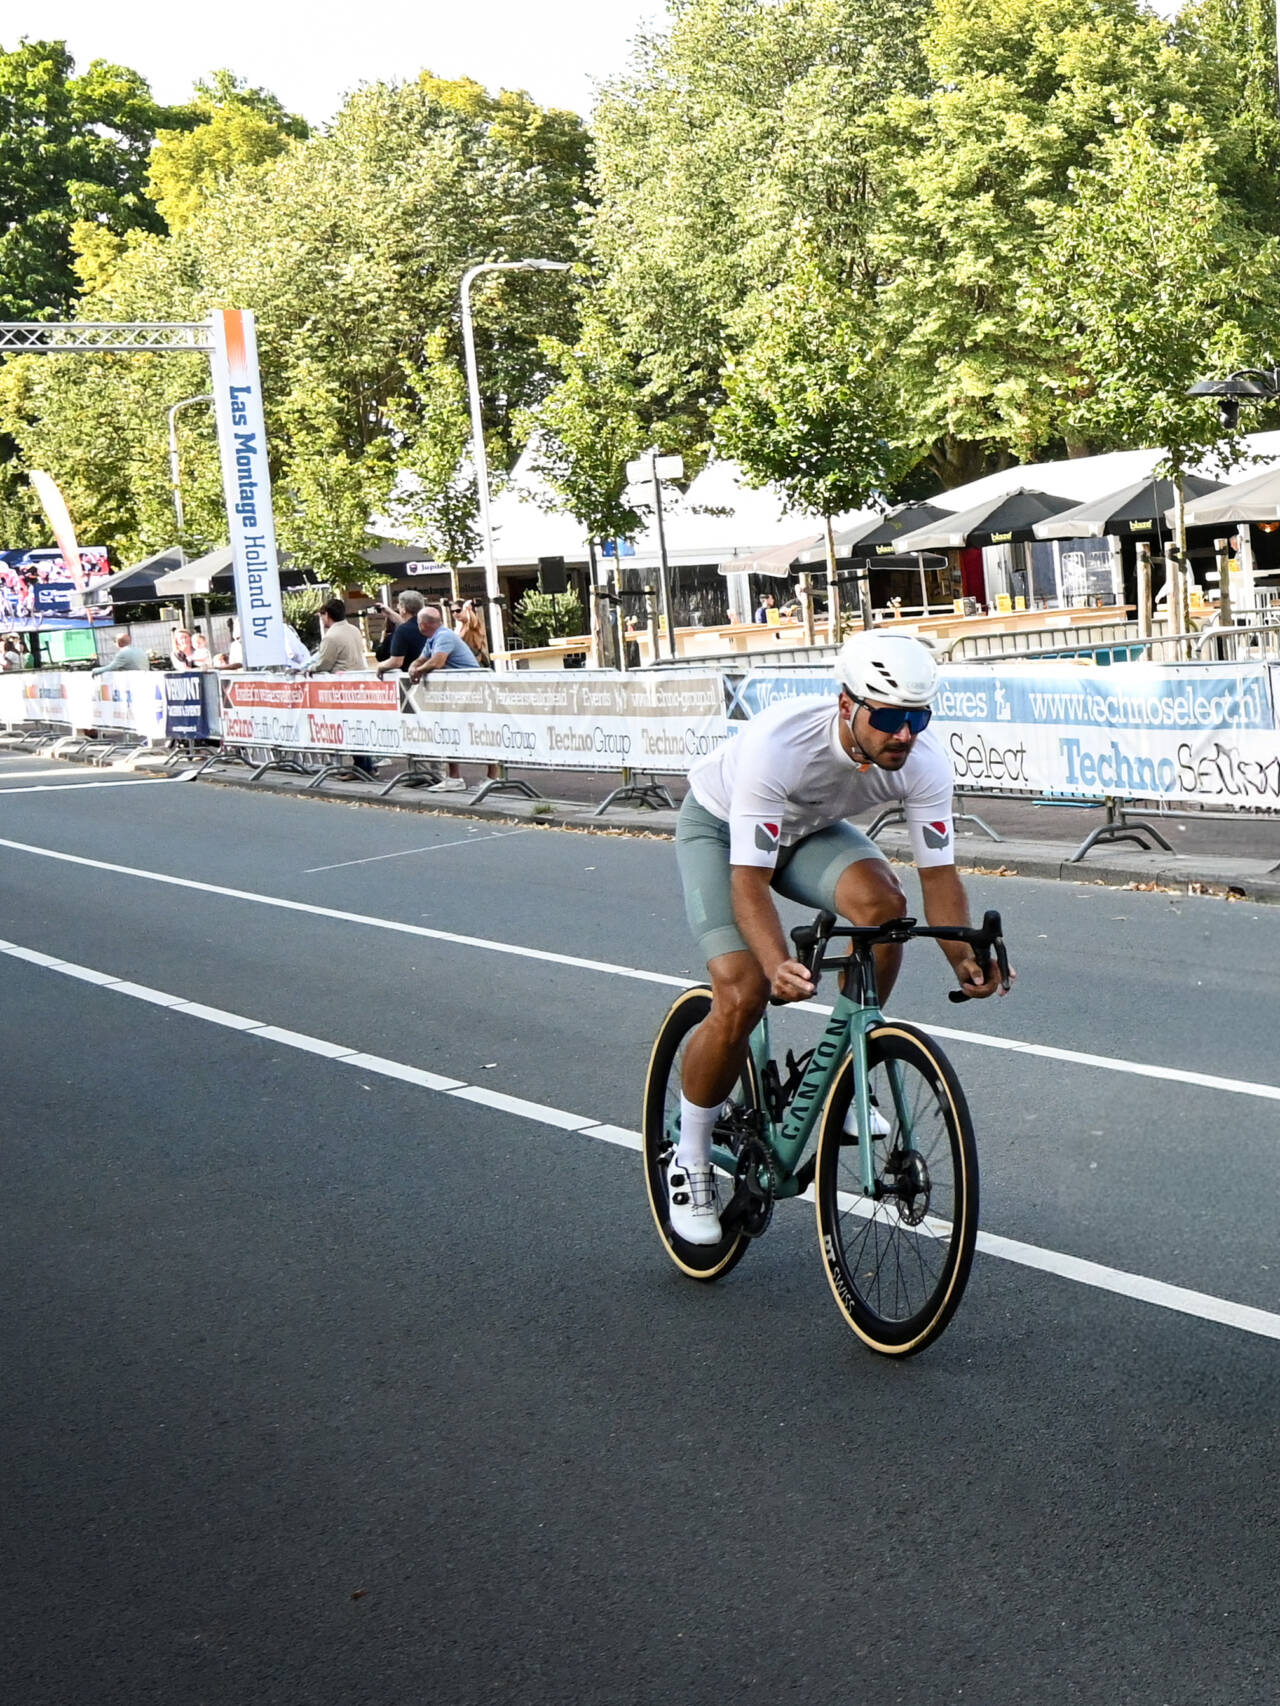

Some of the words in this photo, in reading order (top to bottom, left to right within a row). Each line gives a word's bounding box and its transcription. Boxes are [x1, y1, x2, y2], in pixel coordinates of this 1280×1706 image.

[229, 386, 252, 426] Las
[234, 433, 259, 528] Montage
[244, 535, 271, 610] Holland
[252, 616, 273, 639] bv
[931, 681, 987, 718] ières
[468, 722, 536, 756] TechnoGroup
[547, 726, 631, 761] TechnoGroup
[641, 728, 728, 756] TechnoGrou
[950, 732, 1029, 782] Select
[781, 1018, 849, 1140] CANYON
[833, 1266, 856, 1315] SWISS
